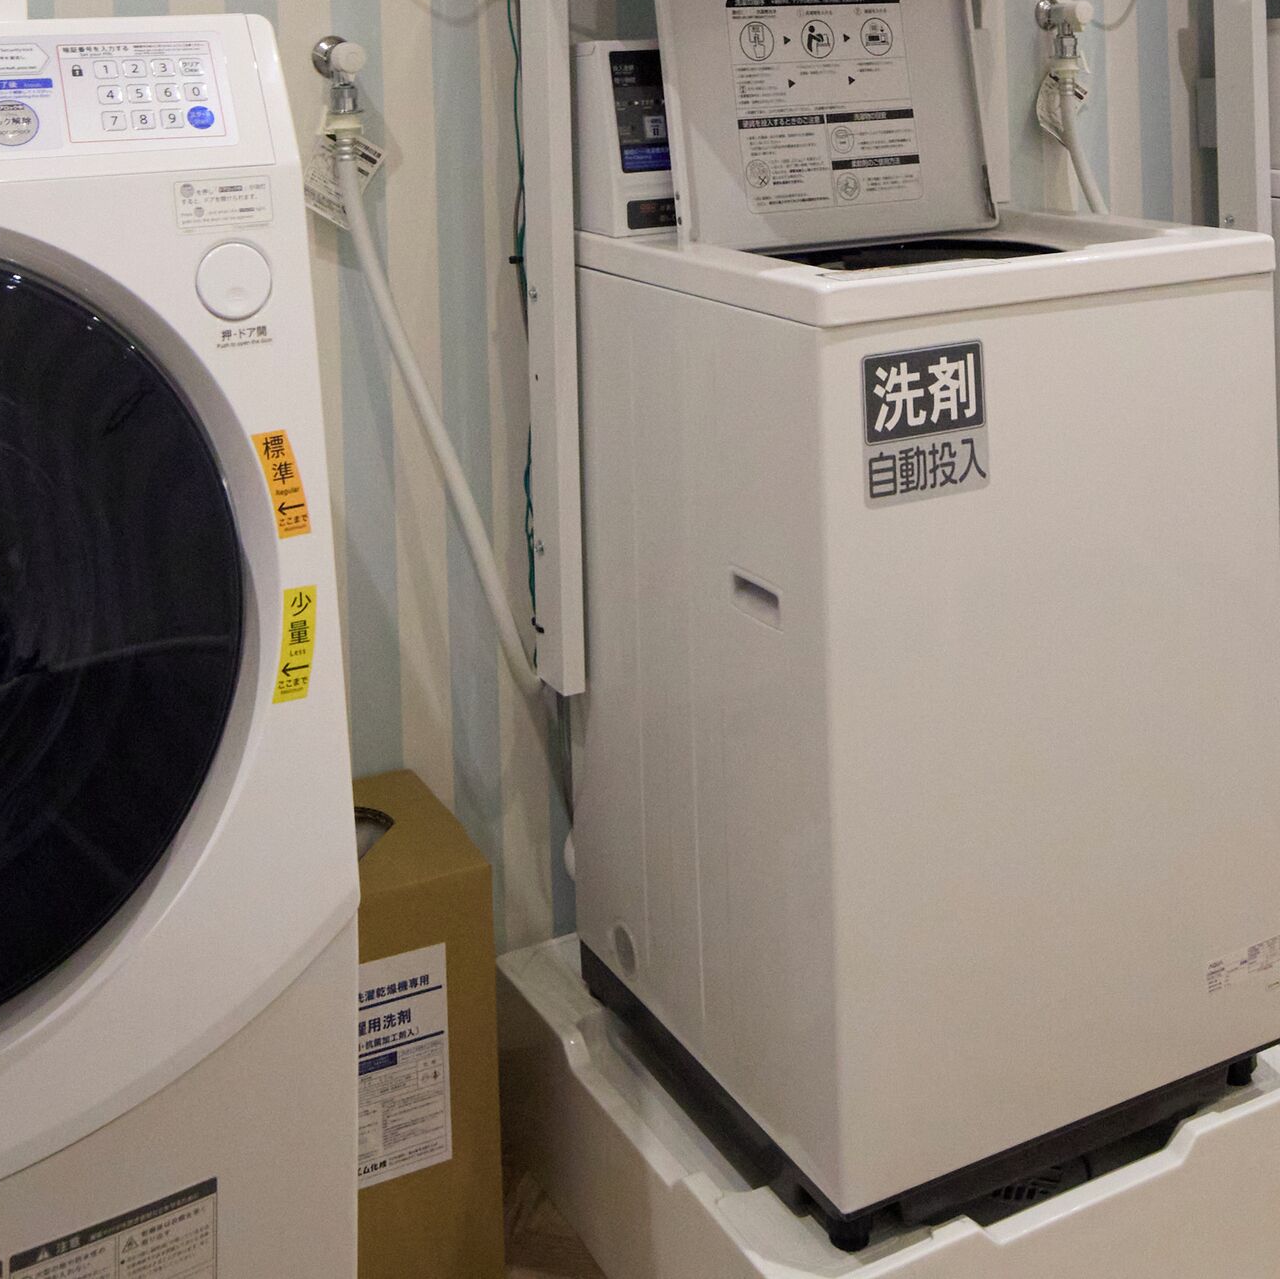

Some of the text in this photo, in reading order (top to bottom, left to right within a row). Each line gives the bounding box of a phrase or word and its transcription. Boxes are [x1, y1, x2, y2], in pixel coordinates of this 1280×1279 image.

[103, 65, 108, 74] 1
[131, 64, 139, 73] 2
[160, 63, 167, 73] 3
[106, 90, 115, 100] 4
[135, 89, 143, 99] 5
[164, 88, 172, 98] 6
[192, 87, 201, 97] 0
[111, 116, 118, 126] 7
[139, 115, 148, 125] 8
[168, 114, 176, 124] 9
[873, 352, 977, 433] 洗剤
[262, 434, 295, 485] 標準
[868, 437, 987, 499] 自動投入
[275, 486, 300, 497] Regular
[278, 514, 308, 527] ここまで
[287, 591, 312, 646] 少量
[289, 648, 307, 658] Less
[277, 677, 308, 690] ここまで
